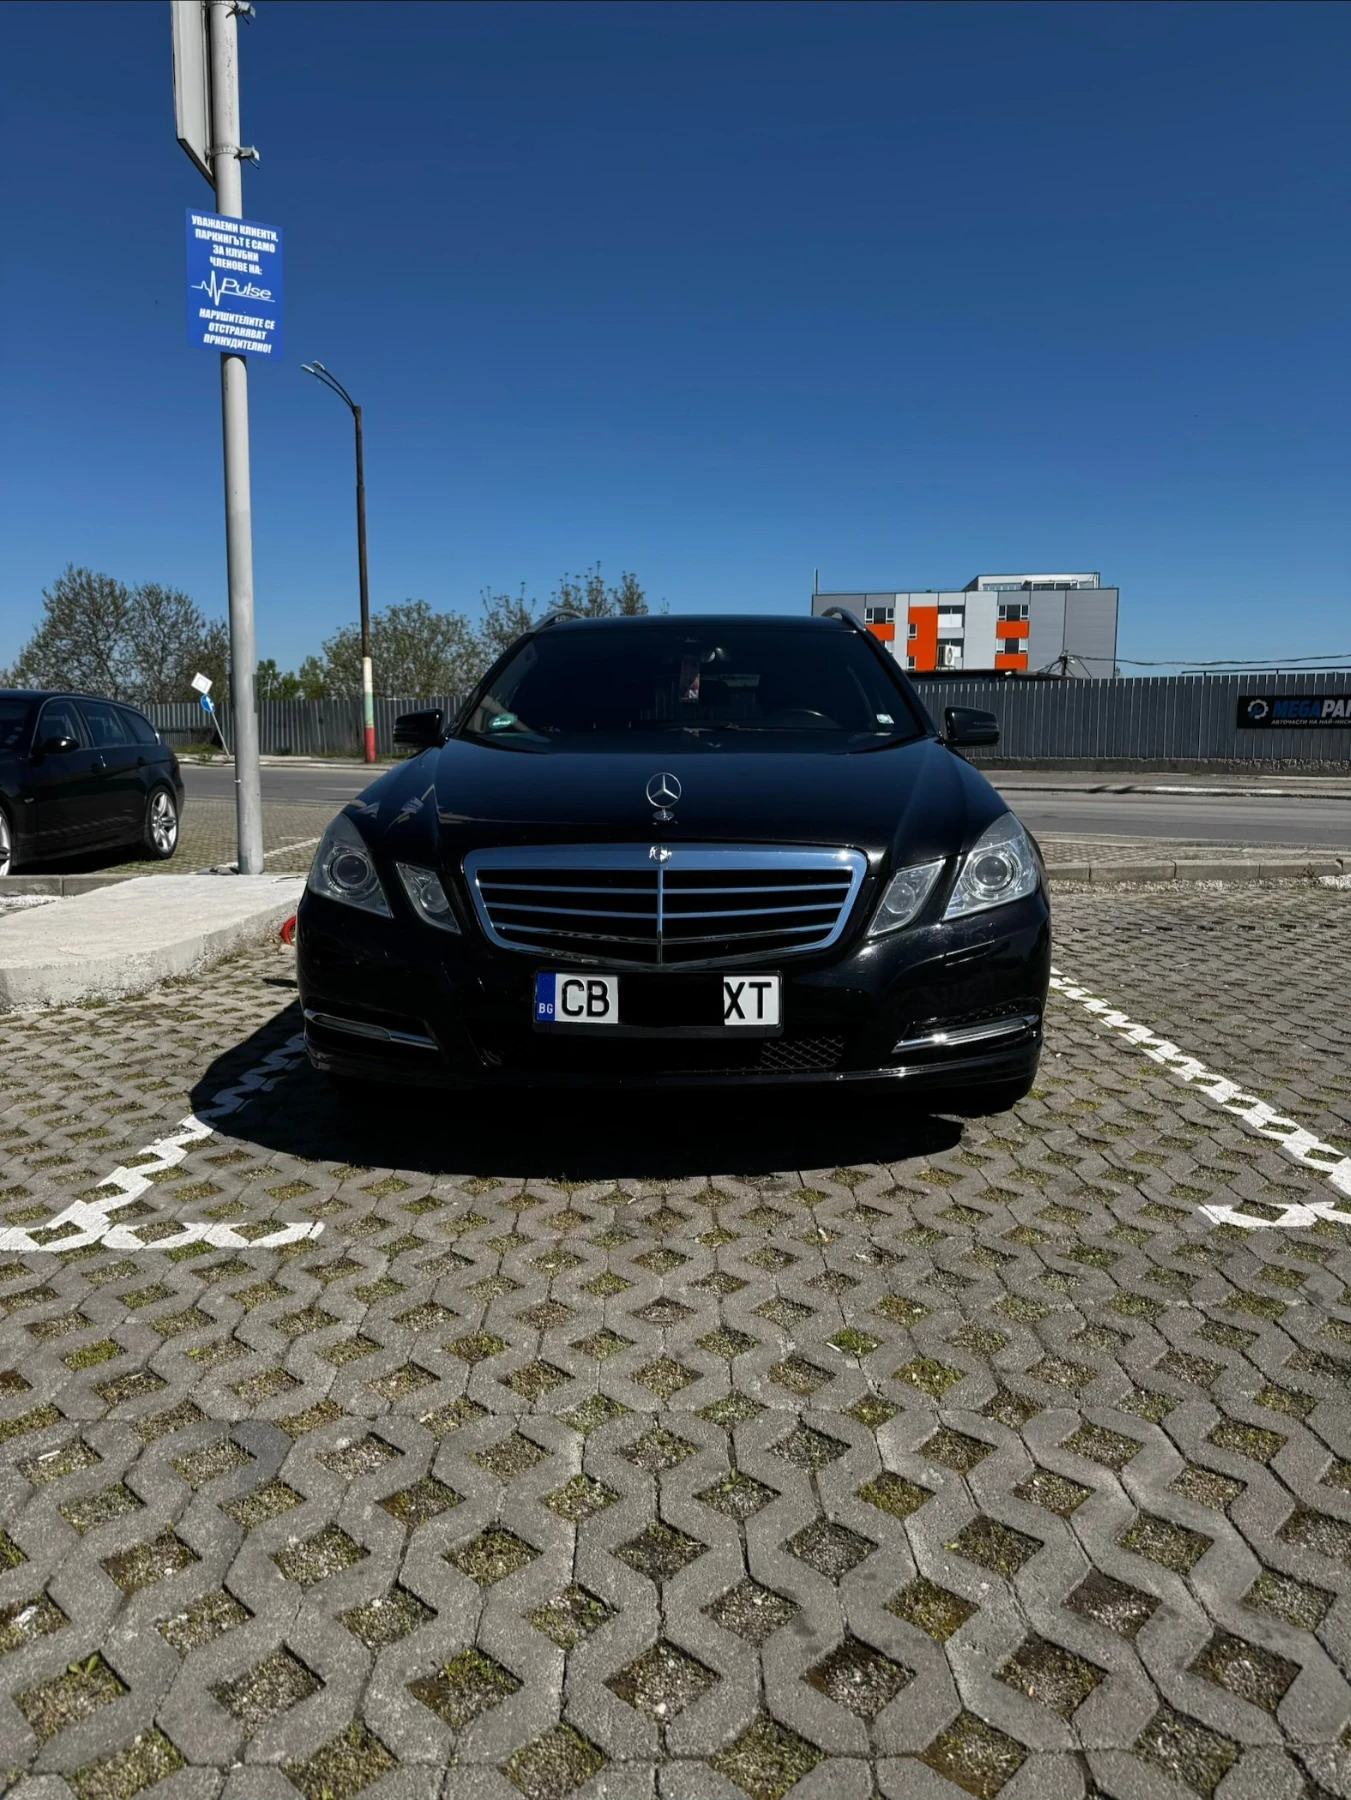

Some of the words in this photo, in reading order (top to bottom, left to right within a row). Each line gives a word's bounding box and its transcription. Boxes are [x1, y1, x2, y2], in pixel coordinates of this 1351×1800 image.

[191, 215, 238, 233] УВАЖАЕМИ
[239, 225, 278, 242] КЛИЕНТИ,
[195, 228, 244, 247] ПАРКИНГЪТ
[245, 238, 250, 248] Е
[251, 240, 276, 253] САМО
[212, 244, 224, 255] ЗА
[225, 247, 259, 262] КЛУБНИ
[209, 256, 248, 272] ЧЛЕНОВЕ
[248, 264, 263, 275] НА:
[221, 277, 272, 300] Pulse
[198, 308, 264, 328] НАРУШИТЕЛИТЕ
[264, 319, 276, 330] СЕ
[208, 322, 267, 340] ОТСТРАНЯВАТ
[203, 333, 272, 353] ПРИНУДИТЕЛНО!
[538, 1003, 554, 1014] BG
[561, 979, 610, 1017] CB
[723, 982, 772, 1019] XT
